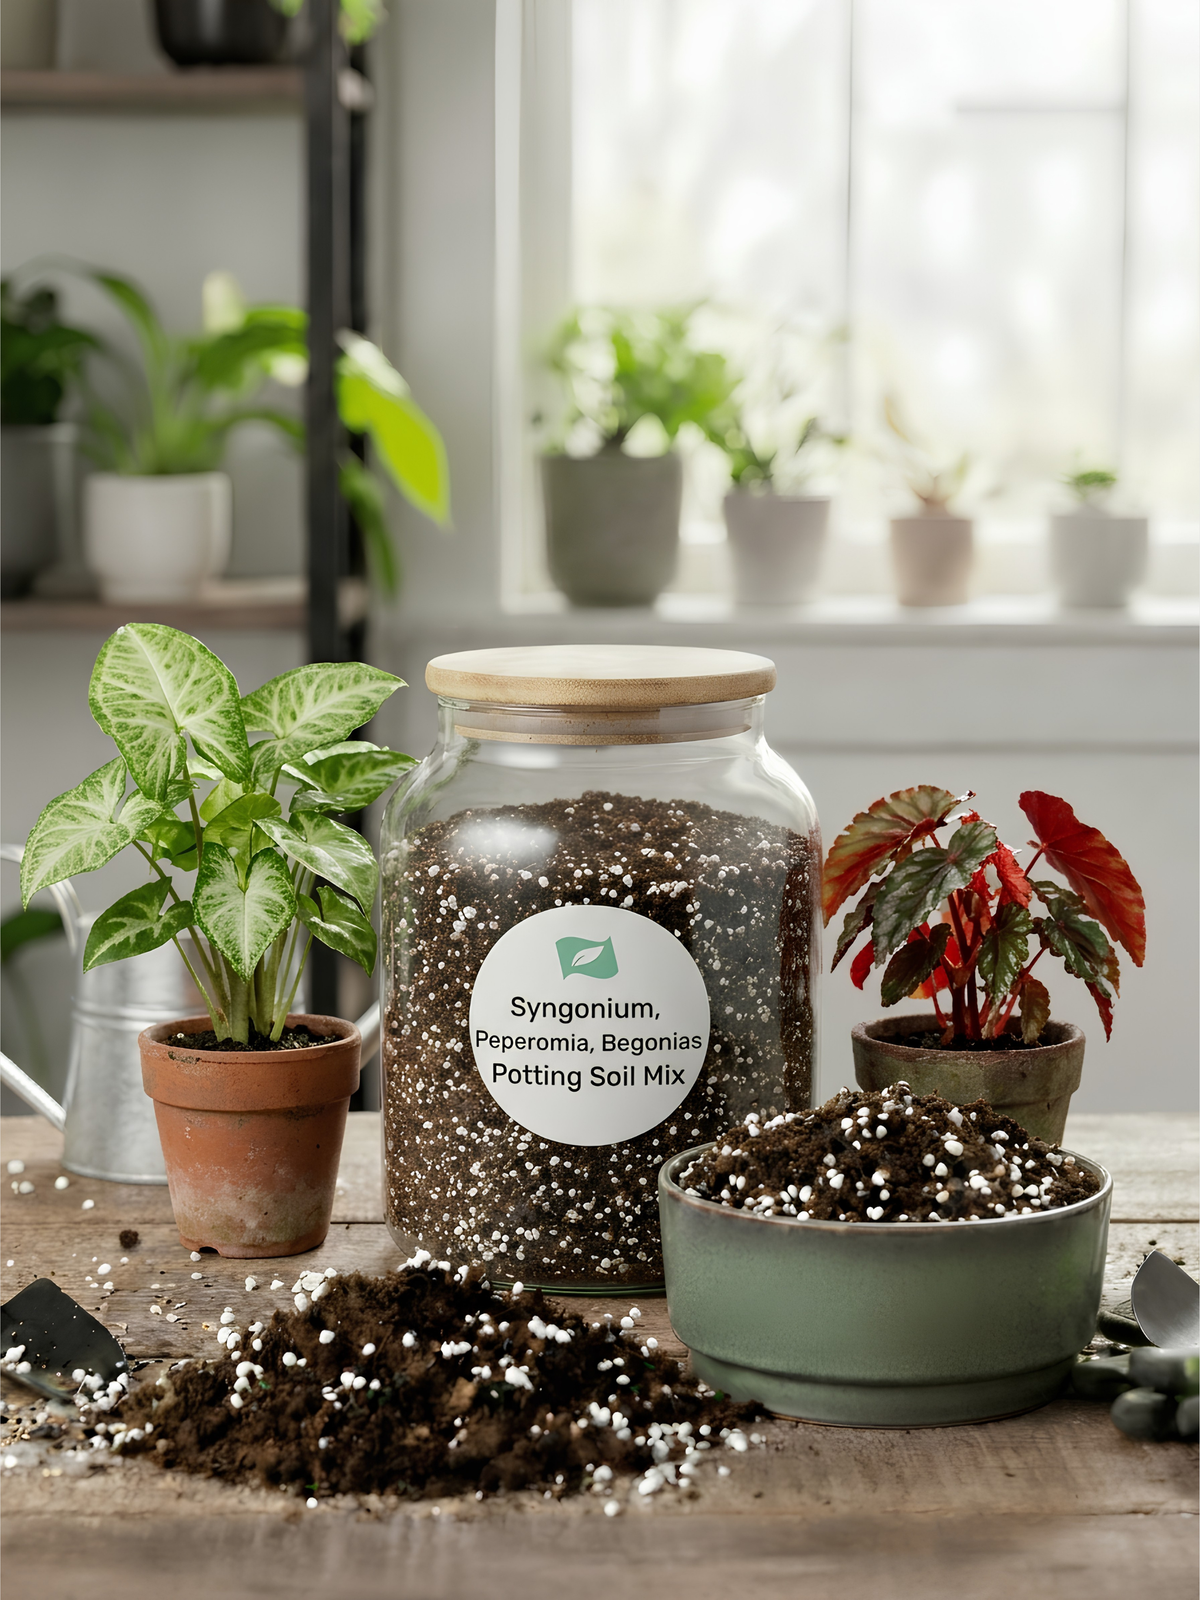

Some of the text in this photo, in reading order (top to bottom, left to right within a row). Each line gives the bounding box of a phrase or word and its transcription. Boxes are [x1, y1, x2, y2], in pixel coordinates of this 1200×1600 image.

[510, 996, 660, 1024] Syngonium,
[475, 1029, 702, 1056] Peperomia, Begonias
[492, 1063, 686, 1092] Potting Soil Mix
